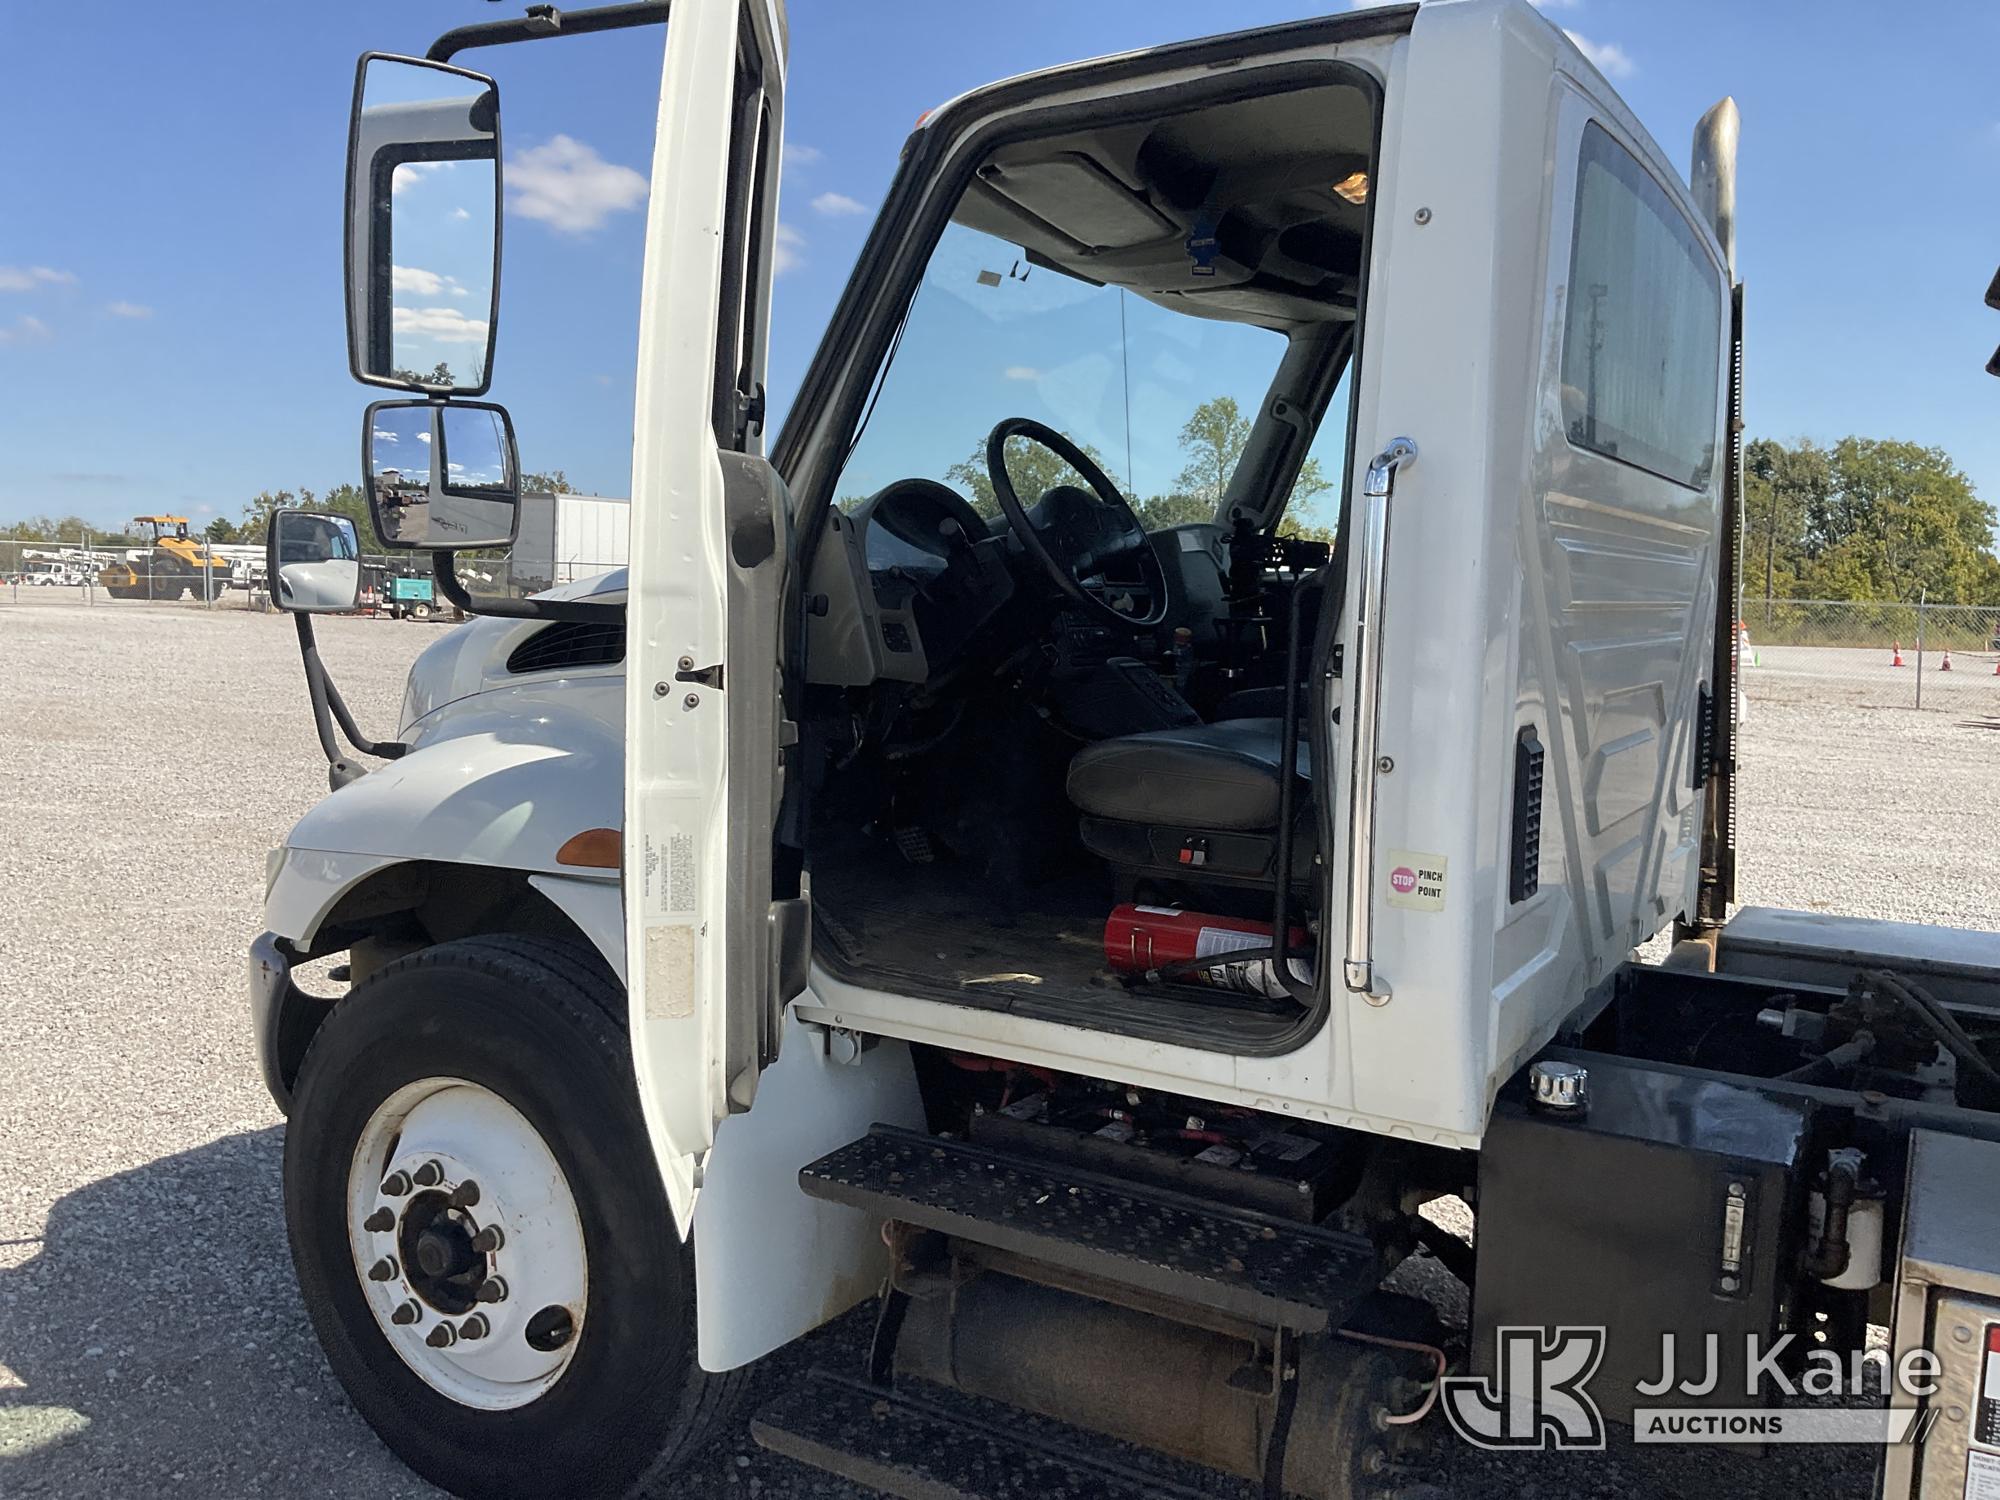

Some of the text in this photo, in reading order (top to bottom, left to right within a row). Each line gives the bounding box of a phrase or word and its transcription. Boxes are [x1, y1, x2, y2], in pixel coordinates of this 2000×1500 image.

[1392, 874, 1415, 887] STOP
[1418, 869, 1443, 882] PINCH
[1417, 886, 1442, 898] POINT
